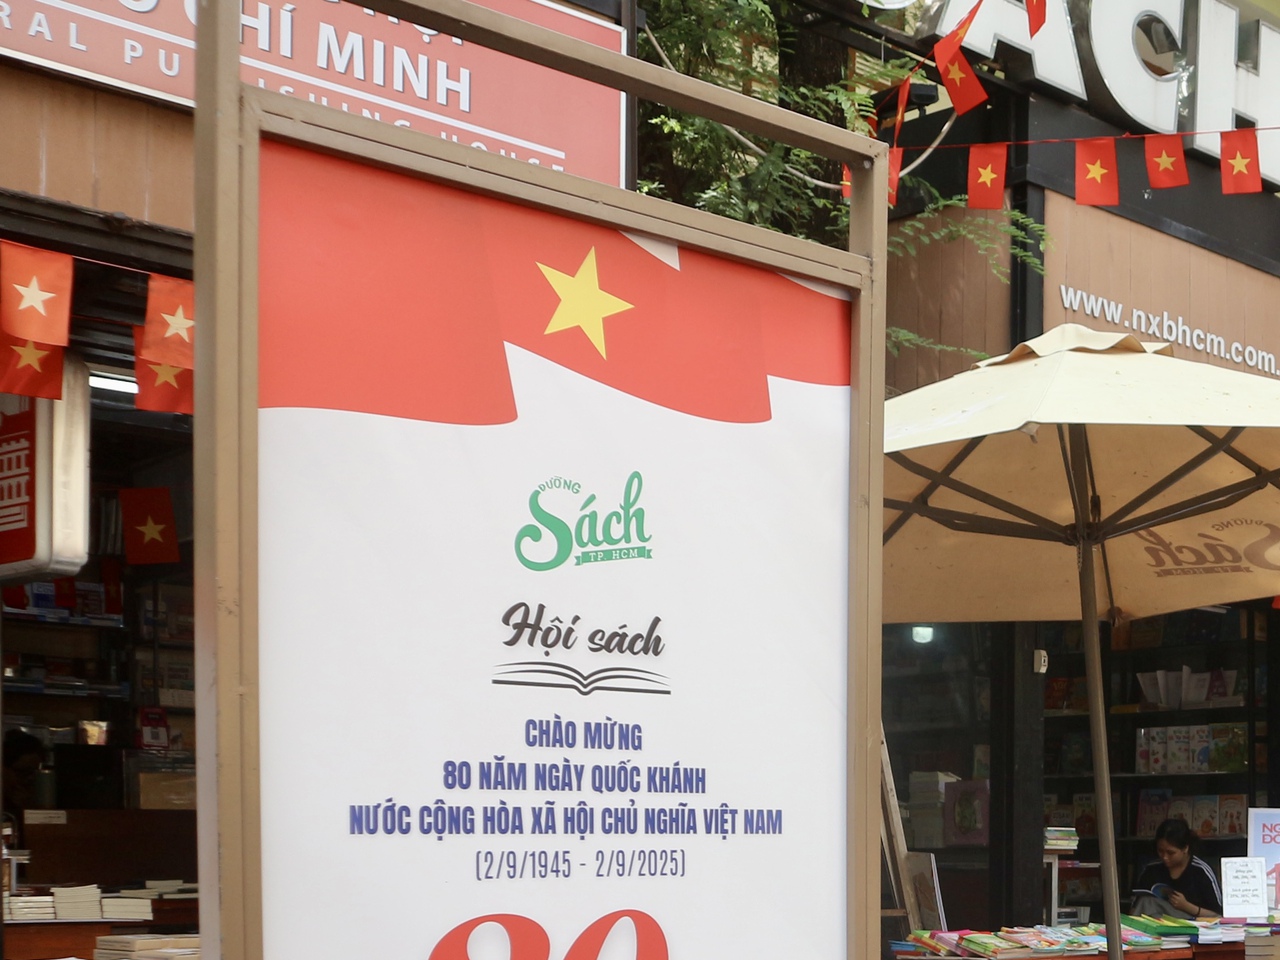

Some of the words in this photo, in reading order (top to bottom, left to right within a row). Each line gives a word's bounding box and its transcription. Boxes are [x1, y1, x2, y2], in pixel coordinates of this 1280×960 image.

[316, 21, 471, 114] MINH
[514, 471, 652, 571] Sách
[588, 552, 607, 562] TP.
[612, 549, 638, 560] HCM
[501, 602, 581, 657] Hội
[587, 616, 666, 657] sách
[524, 713, 577, 748] CHÀO
[583, 716, 643, 751] MỪNG
[443, 760, 472, 790] 80
[478, 755, 528, 791] NĂM
[534, 757, 585, 792] NGÀY
[591, 759, 641, 794] QUỐC
[647, 761, 707, 794] KHÁNH
[349, 797, 411, 835] NƯỚC
[419, 799, 475, 841] CỘNG
[482, 799, 524, 835] HÒA
[530, 801, 557, 835] XÃ
[563, 801, 595, 841] HỘI
[601, 799, 638, 835] CHỦ
[644, 802, 698, 835] NGHĨA
[703, 803, 738, 840] VIỆT
[744, 808, 783, 835] NAM
